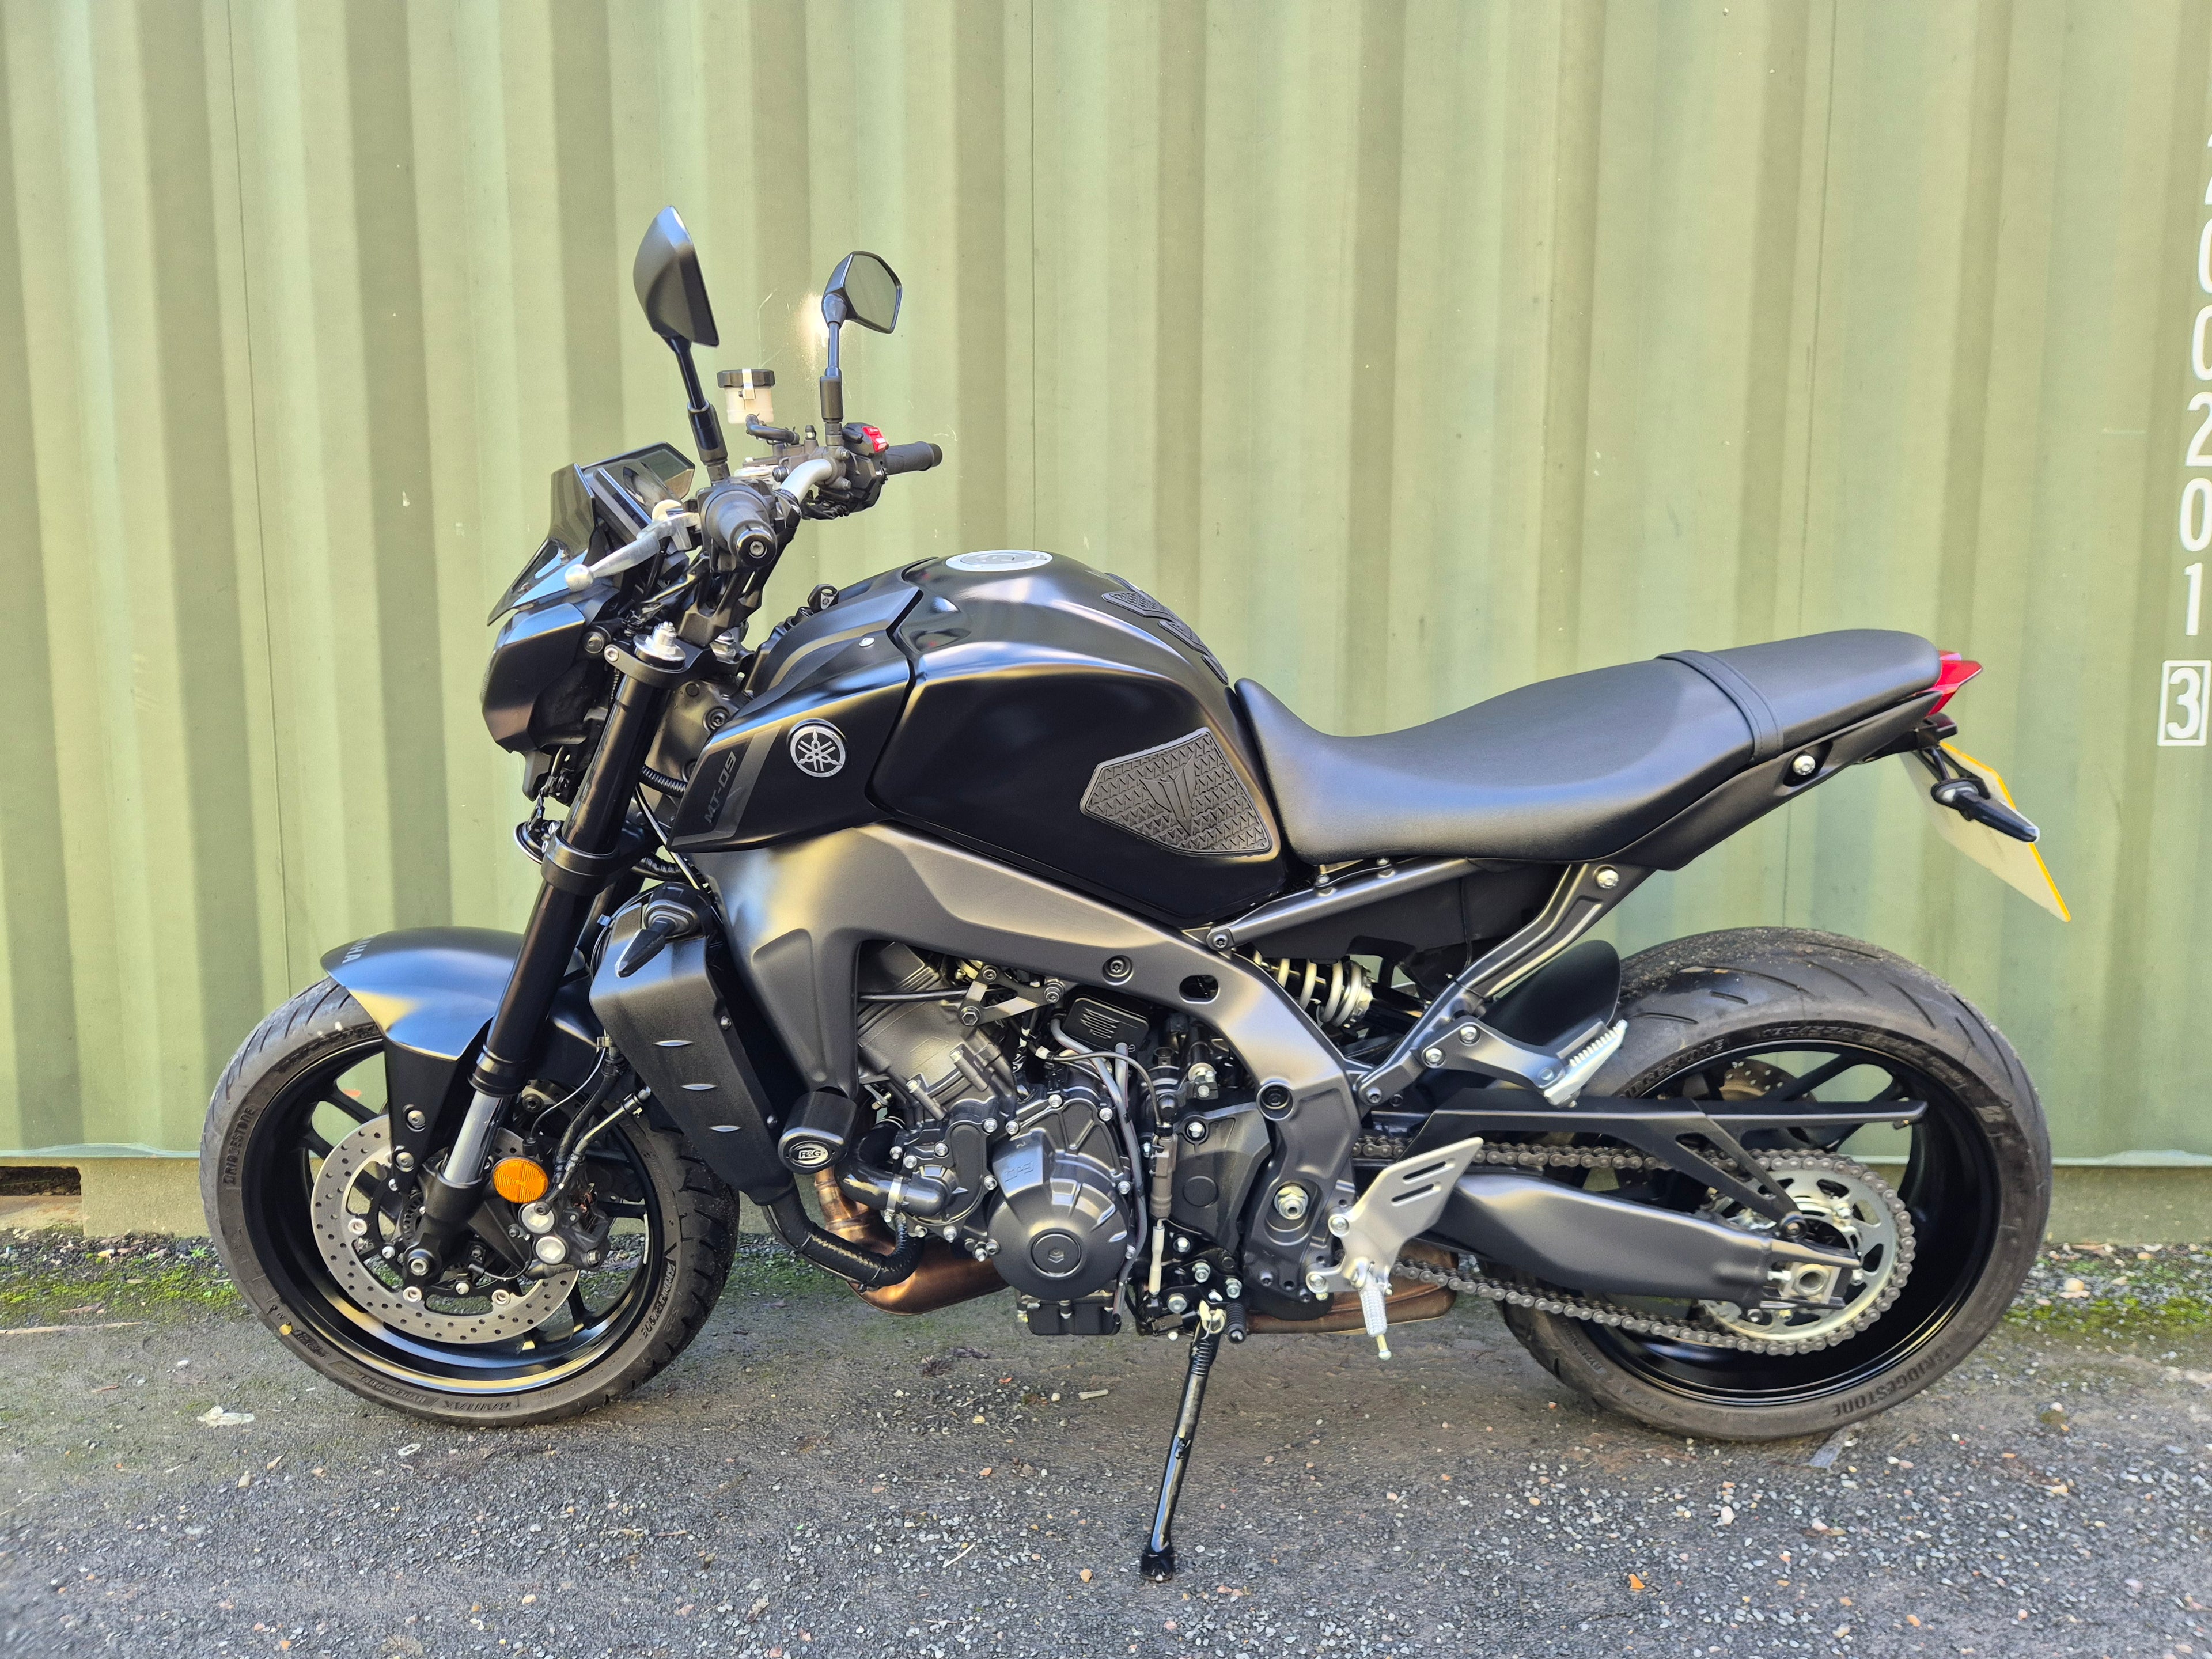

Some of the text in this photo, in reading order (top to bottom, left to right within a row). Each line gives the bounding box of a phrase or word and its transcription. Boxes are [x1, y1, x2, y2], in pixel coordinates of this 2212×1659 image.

[2166, 666, 2201, 740] 3
[704, 750, 738, 824] MT-09
[222, 1106, 255, 1185] BRIDGESTONE
[799, 1149, 821, 1159] R&G
[640, 1260, 676, 1339] BRIDGESTONE
[1832, 1345, 1950, 1418] BRIDGESTONE
